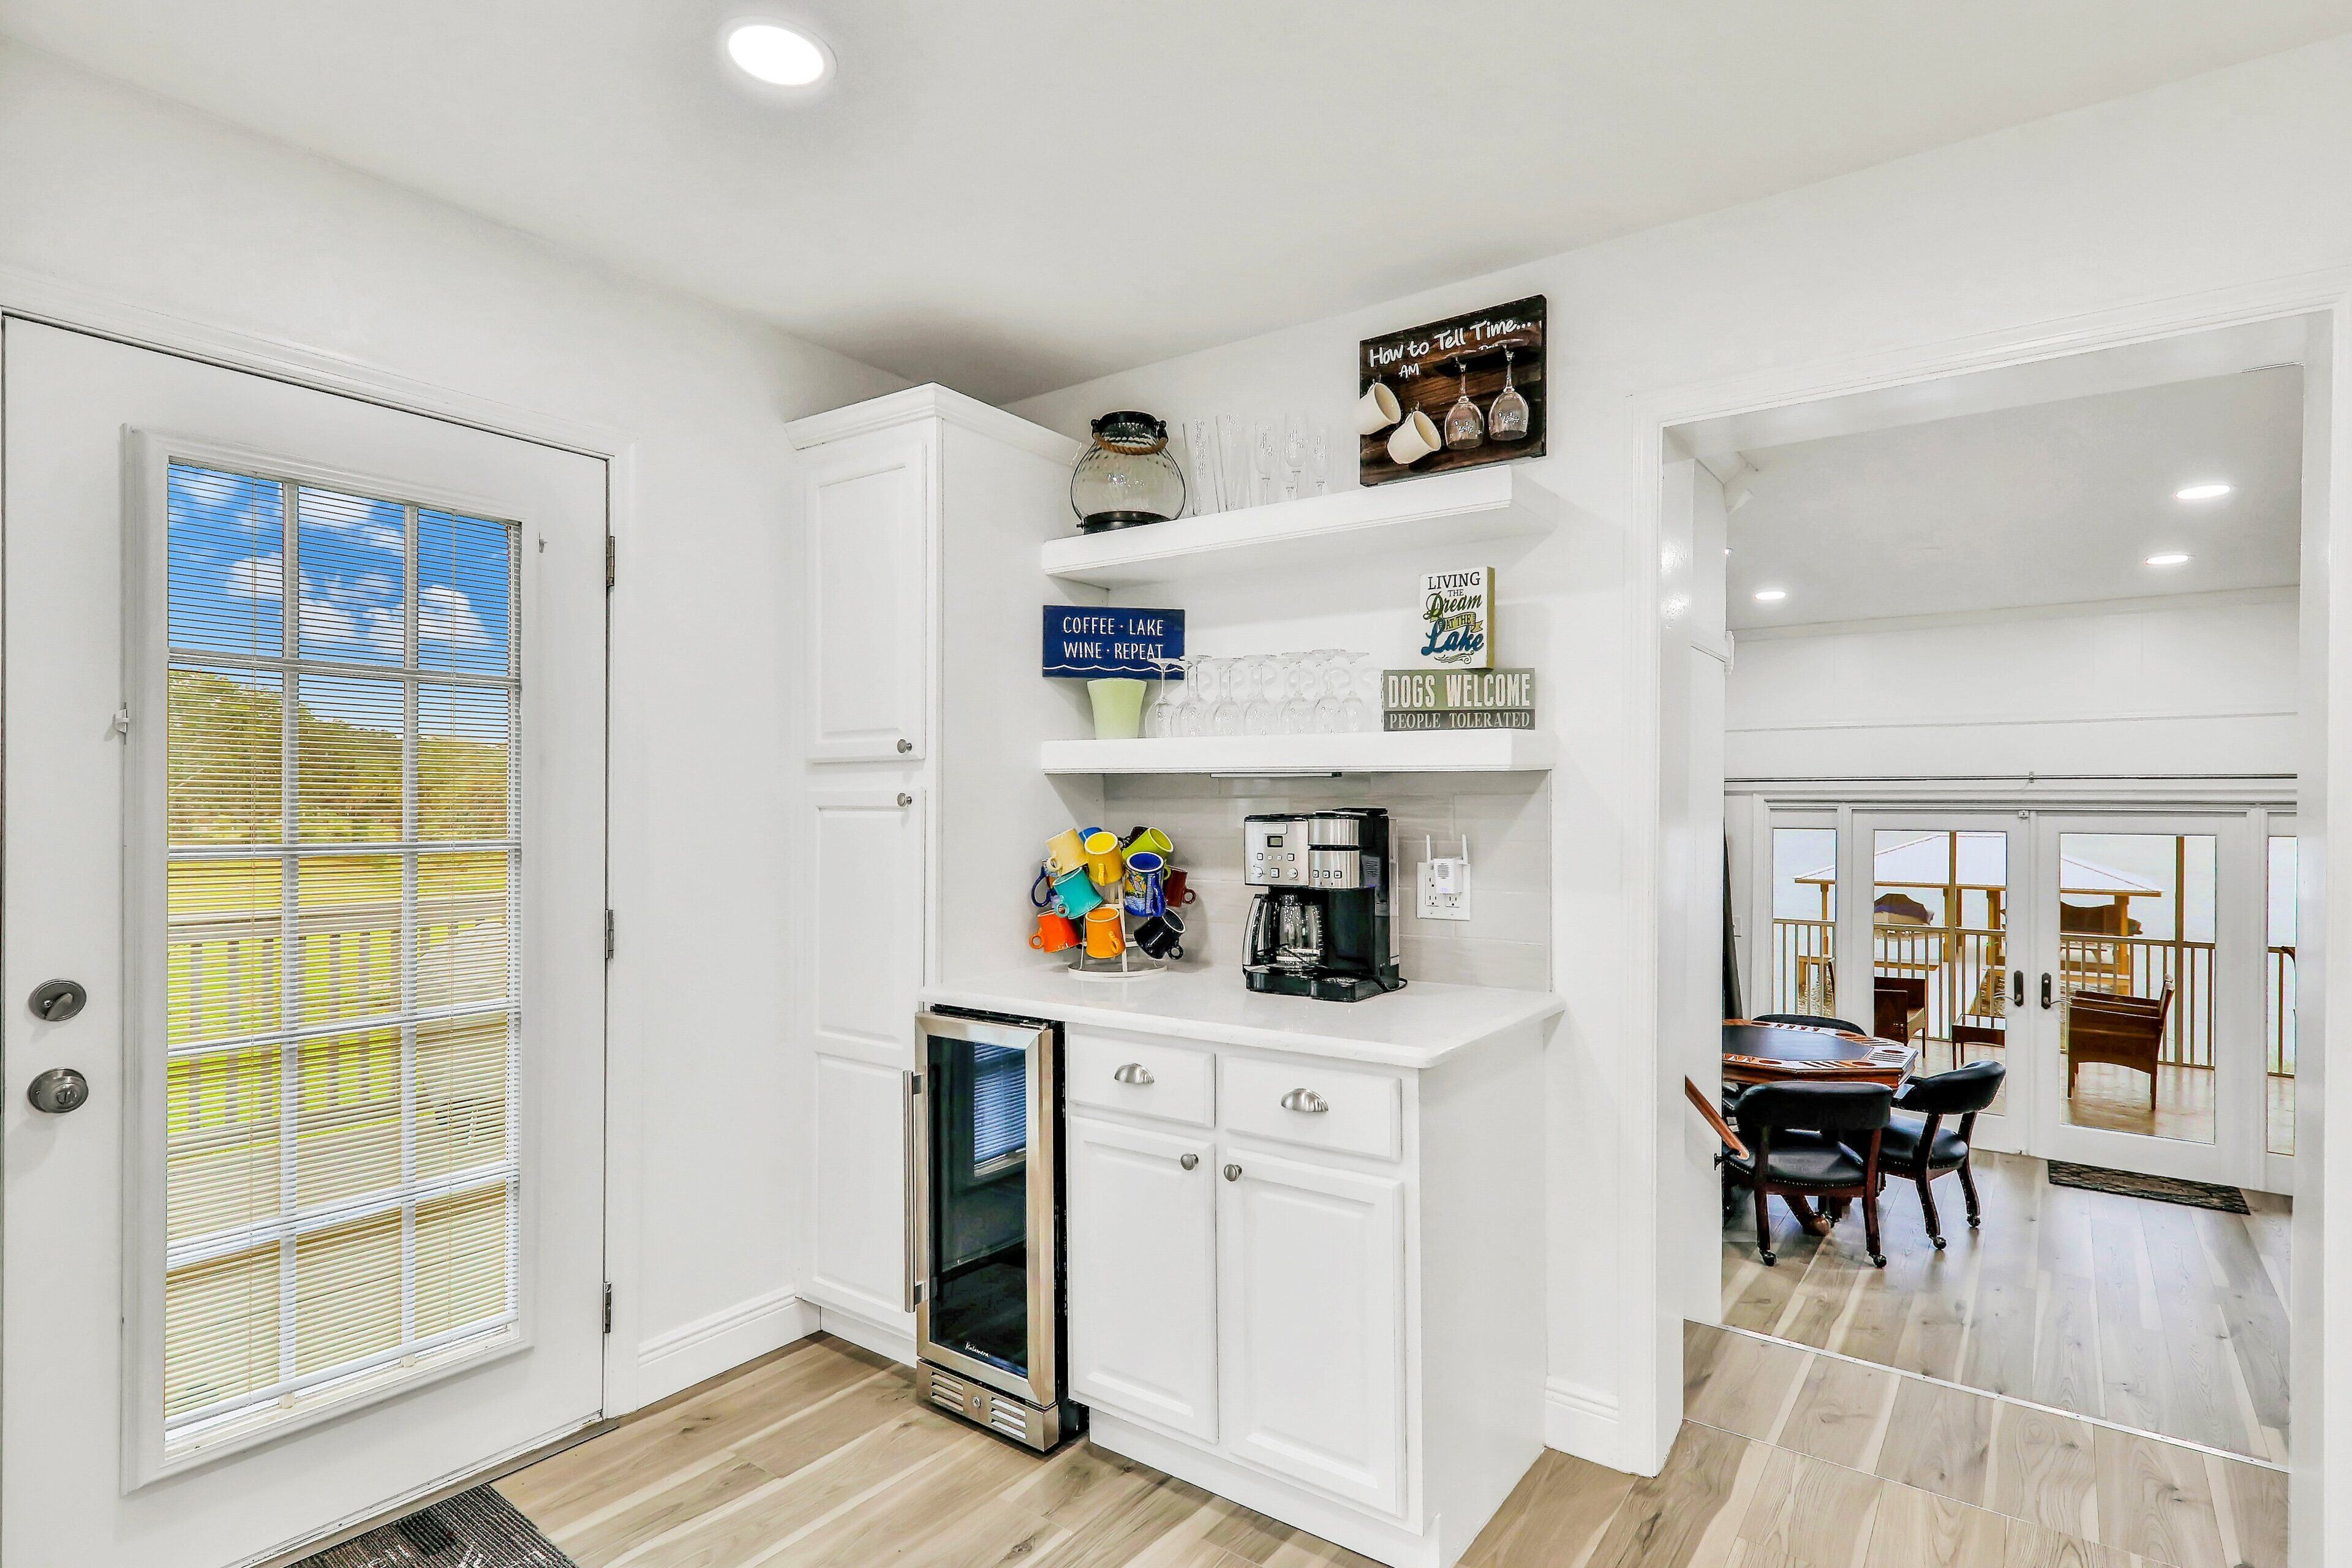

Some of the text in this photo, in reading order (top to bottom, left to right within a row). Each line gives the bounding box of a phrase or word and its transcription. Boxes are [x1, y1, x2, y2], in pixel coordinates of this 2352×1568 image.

[1369, 344, 1404, 368] How
[1407, 341, 1430, 357] to
[1434, 327, 1466, 350] Tell
[1398, 363, 1420, 379] AM
[1428, 571, 1481, 590] LIVING
[1447, 589, 1464, 597] THE
[1423, 591, 1483, 620] Dream
[1063, 617, 1164, 636] COFFEE LAKE
[1446, 614, 1471, 630] AT THE
[1421, 617, 1484, 656] Lake
[1063, 641, 1164, 660] WINE REPEAT
[1388, 674, 1531, 708] DOGS WELCOME
[1389, 711, 1530, 729] PEOPLE TOLERATED
[965, 1342, 989, 1358] Kalamera
